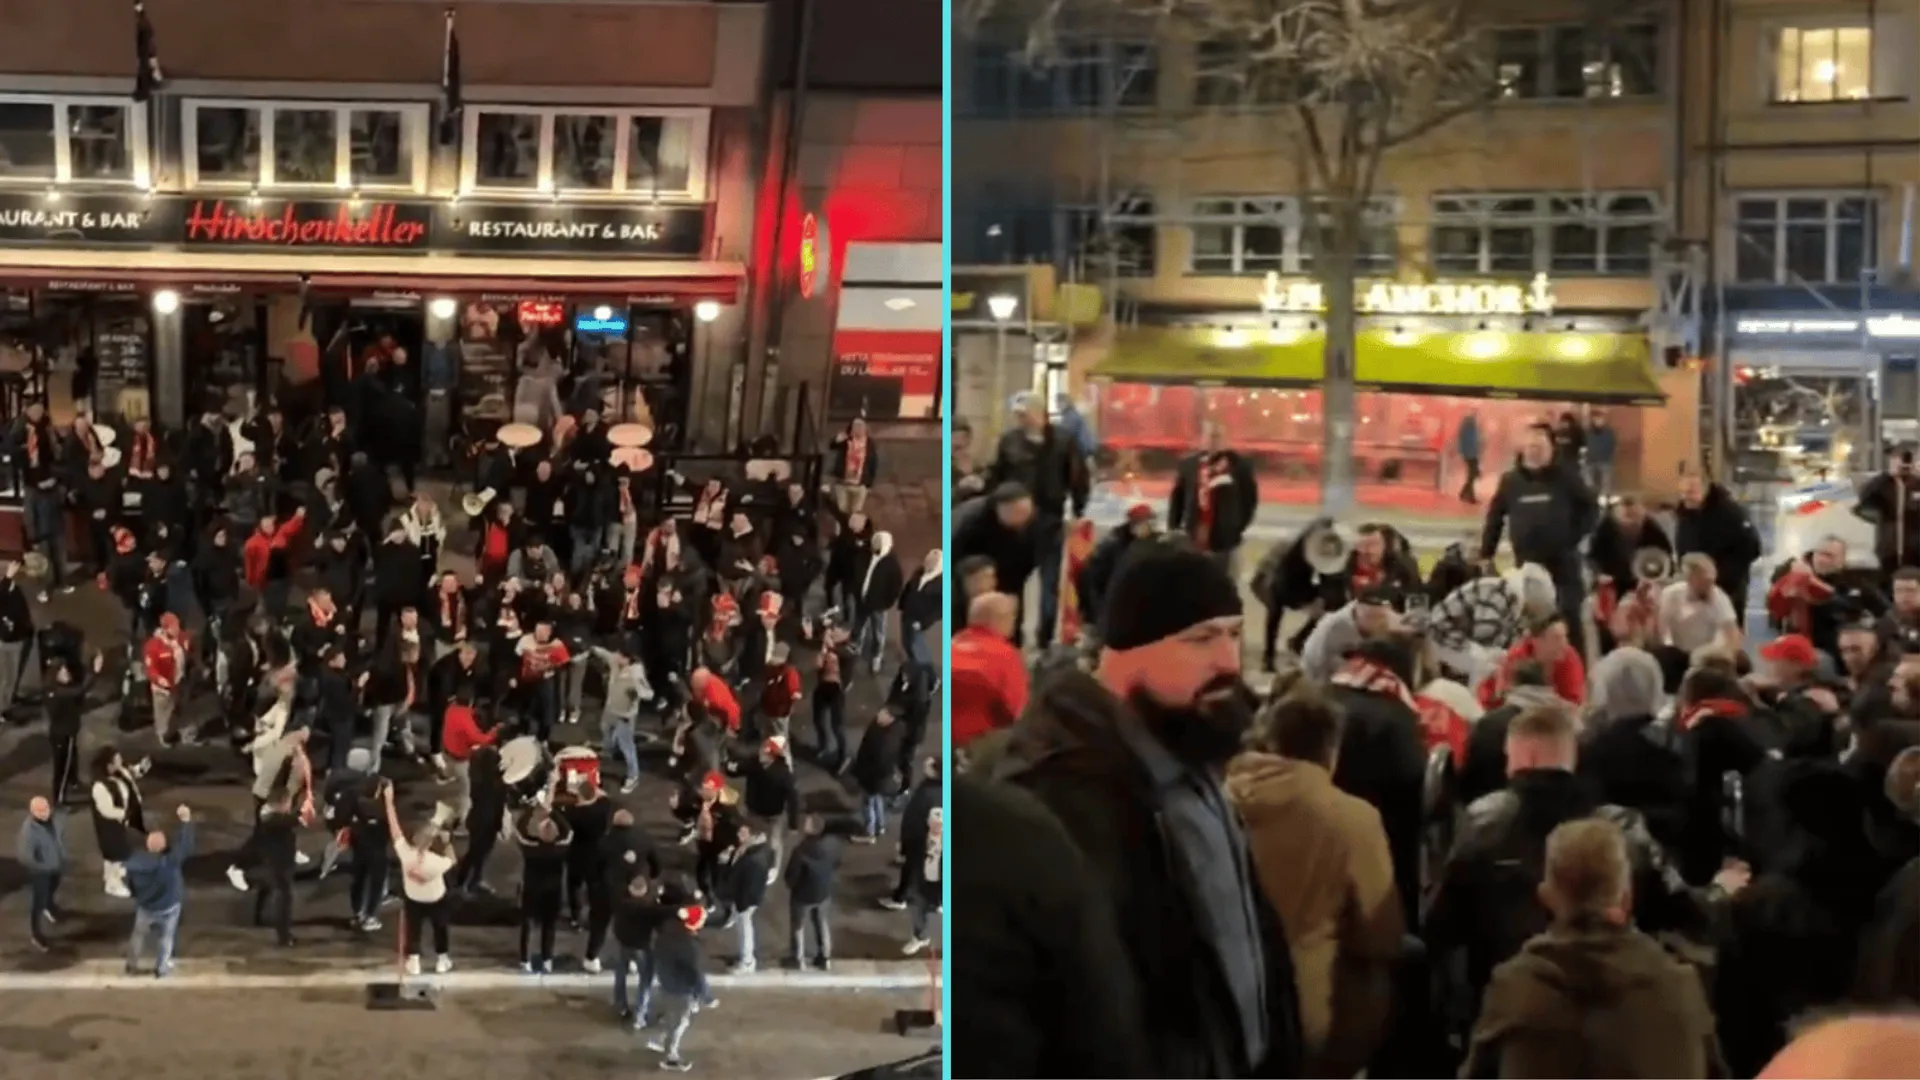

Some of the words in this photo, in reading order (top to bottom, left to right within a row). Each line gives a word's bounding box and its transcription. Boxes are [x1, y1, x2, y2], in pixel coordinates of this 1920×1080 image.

[82, 212, 95, 228] &
[100, 212, 140, 229] BAR
[185, 199, 424, 244] Hirschenkeller
[469, 220, 599, 239] RESTAURANT
[602, 223, 616, 239] &
[620, 224, 659, 240] BAR
[1363, 283, 1524, 314] ANCHOR
